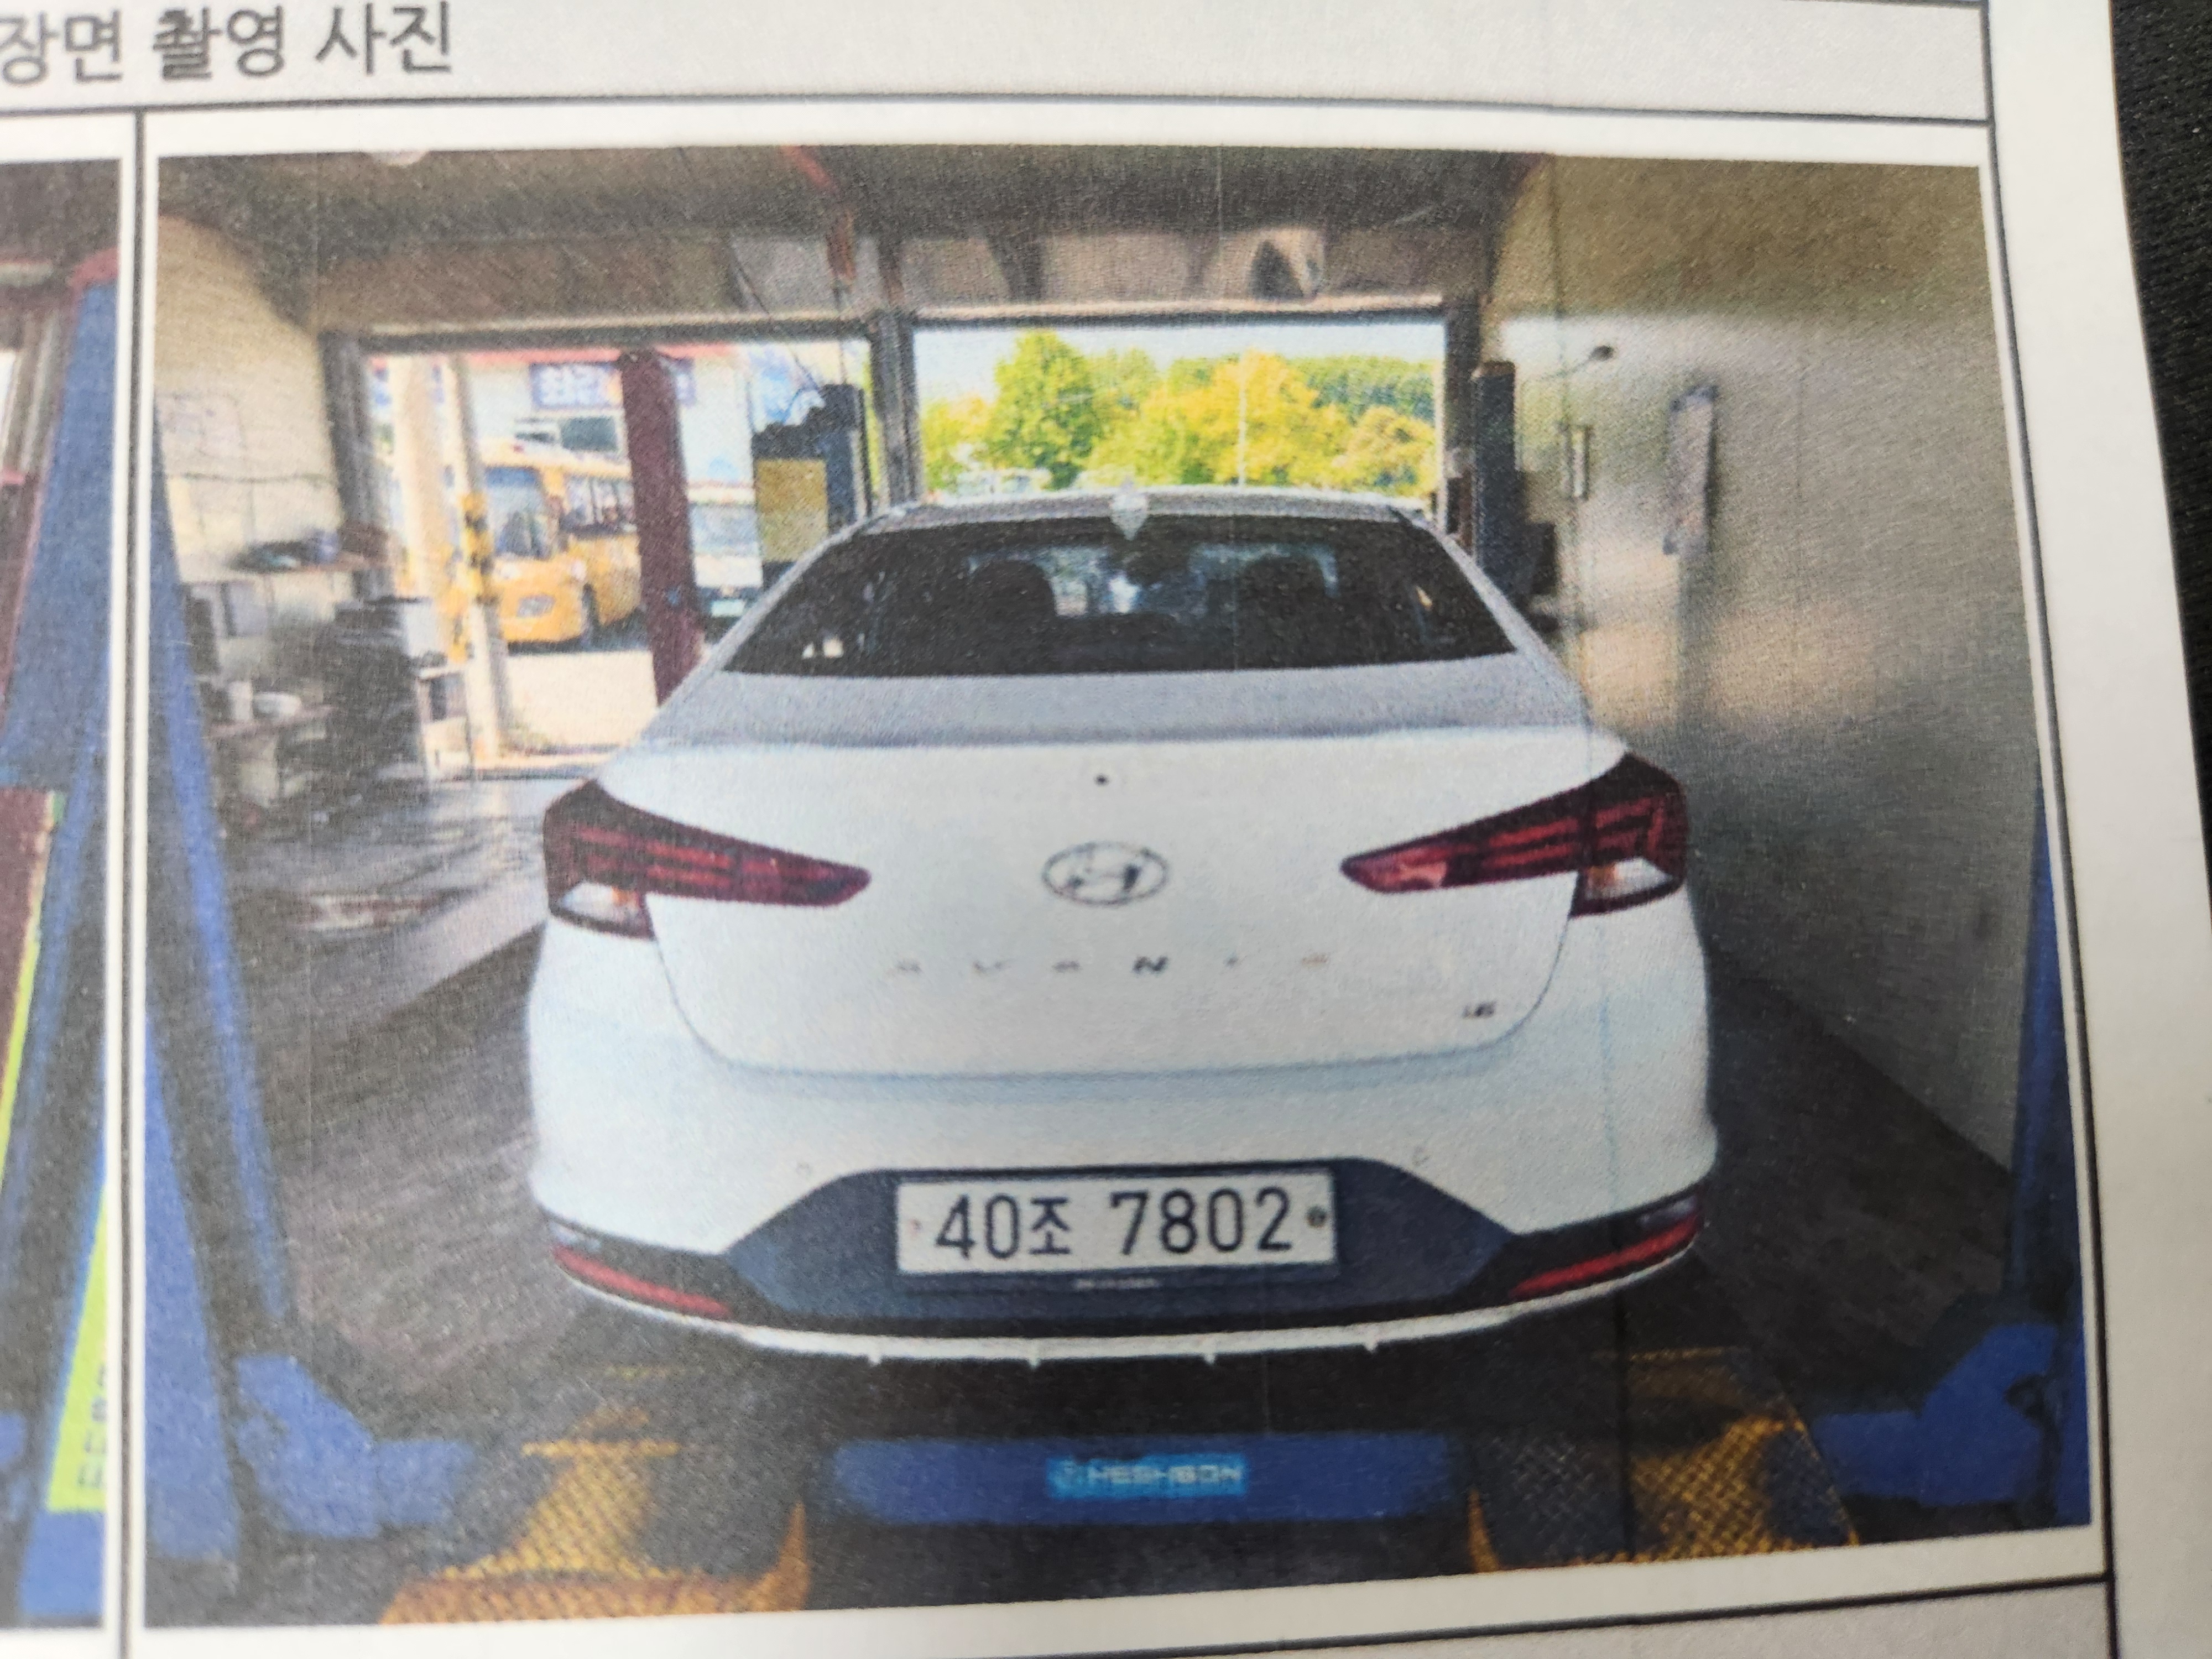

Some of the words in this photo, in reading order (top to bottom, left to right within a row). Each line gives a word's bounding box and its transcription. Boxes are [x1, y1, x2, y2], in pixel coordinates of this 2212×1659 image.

[0, 10, 123, 85] 장면
[153, 6, 285, 81] 촬영
[315, 1, 452, 75] 사진
[895, 953, 1329, 975] AVAN
[935, 1194, 1071, 1260] 40조
[1110, 1186, 1293, 1256] 7802
